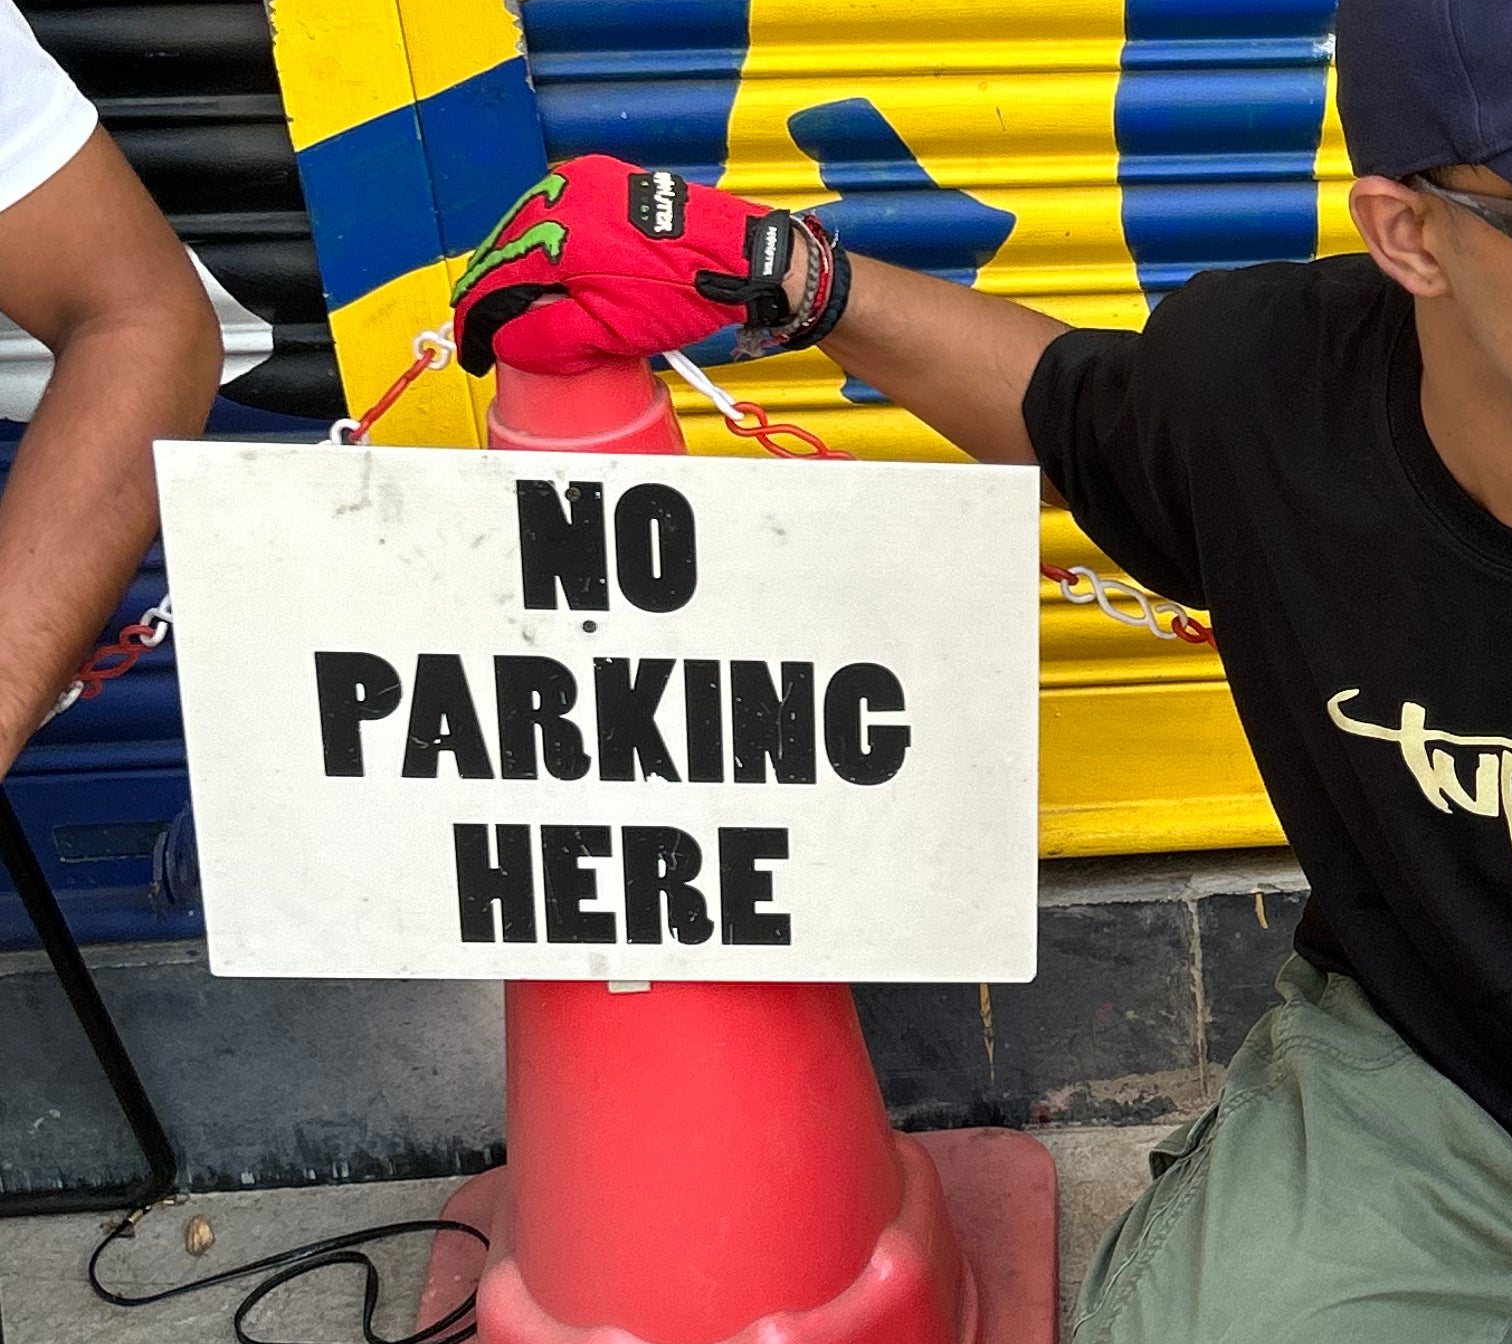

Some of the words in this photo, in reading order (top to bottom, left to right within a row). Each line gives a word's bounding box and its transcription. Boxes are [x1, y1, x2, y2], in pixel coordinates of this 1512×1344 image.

[516, 479, 697, 613] NO
[314, 651, 911, 786] PARKING
[452, 823, 792, 946] HERE
